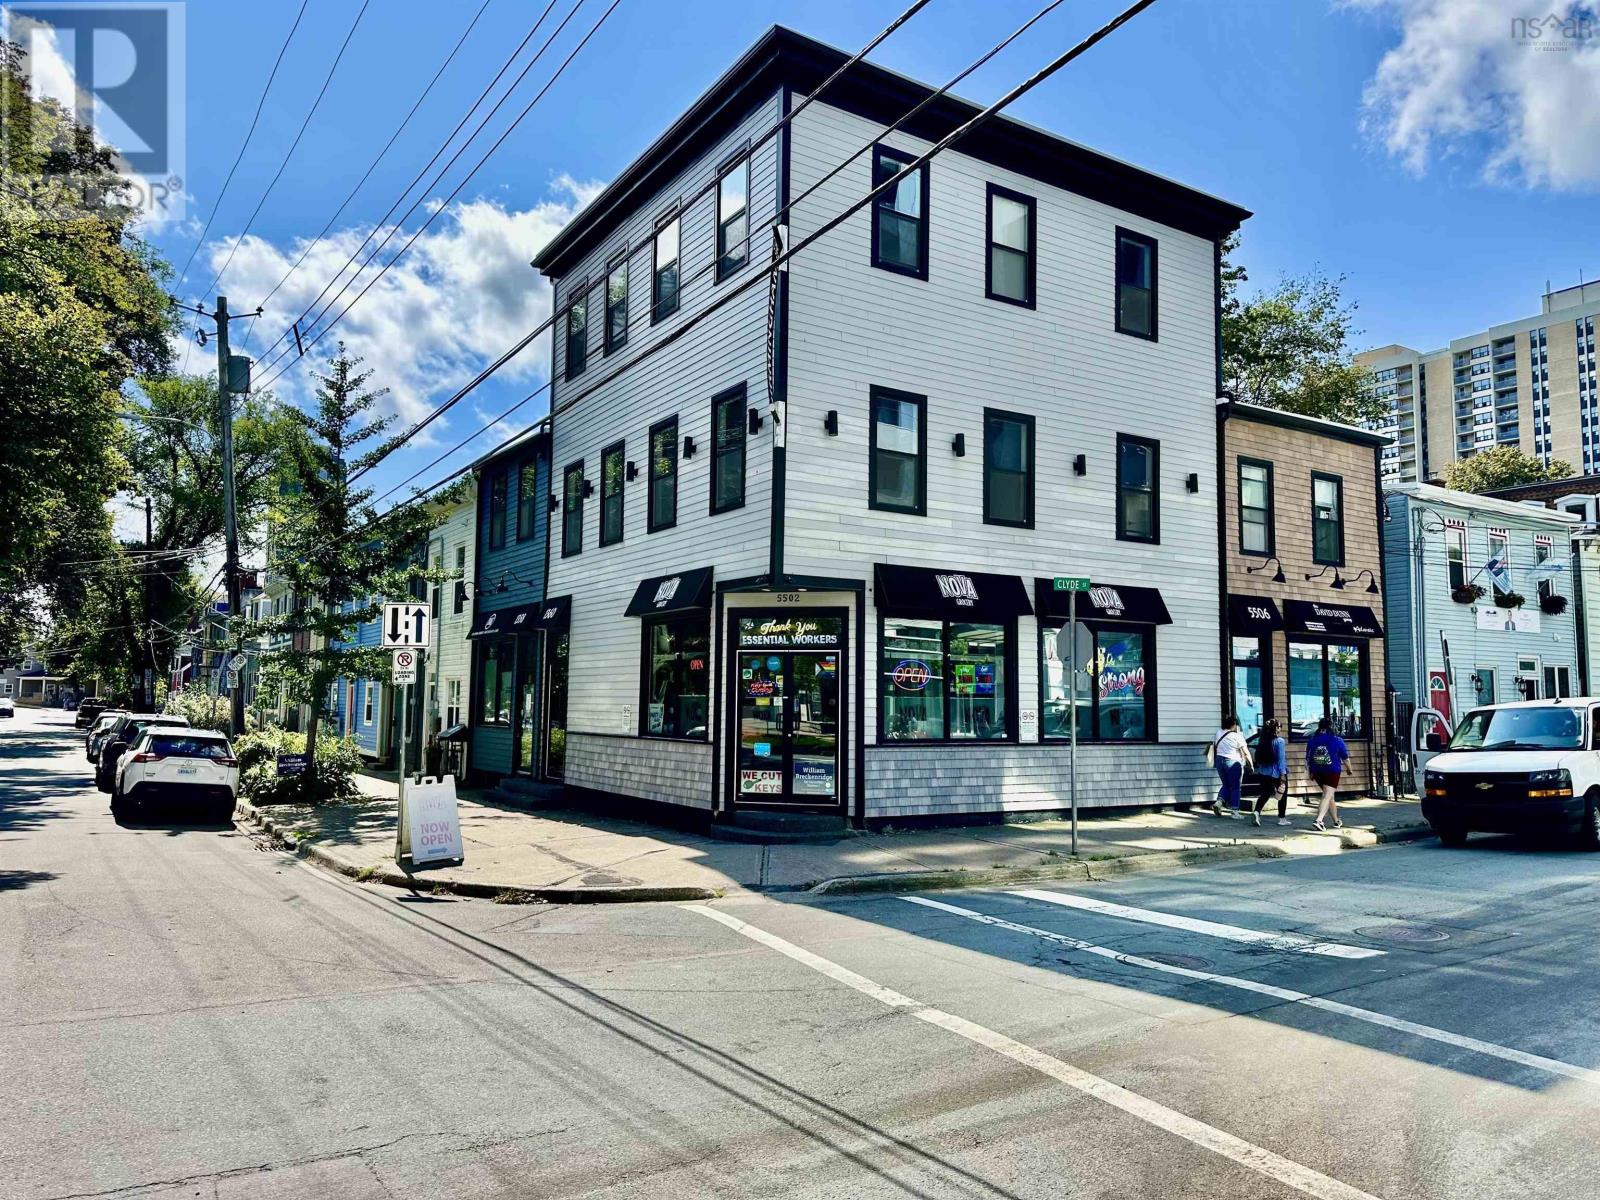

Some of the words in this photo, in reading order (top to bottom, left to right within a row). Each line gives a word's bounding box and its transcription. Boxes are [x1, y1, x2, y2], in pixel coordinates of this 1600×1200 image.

[935, 574, 979, 600] NOVA
[1057, 580, 1079, 589] CLYDE
[777, 594, 800, 602] 5502
[1088, 587, 1125, 610] NOVA
[1247, 606, 1271, 620] 5506
[760, 618, 791, 635] Thank
[795, 621, 818, 637] You
[742, 634, 789, 645] ESSENTIAL
[791, 634, 838, 645] WORKERS
[690, 659, 704, 670] OPEN
[894, 667, 928, 683] OPEN
[1098, 666, 1146, 698] Strong
[742, 771, 758, 780] WE
[761, 771, 782, 780] CUT
[795, 773, 833, 781] Breckenridge
[754, 784, 782, 793] KEYS
[421, 821, 449, 834] NOW
[421, 833, 453, 846] OPEN
